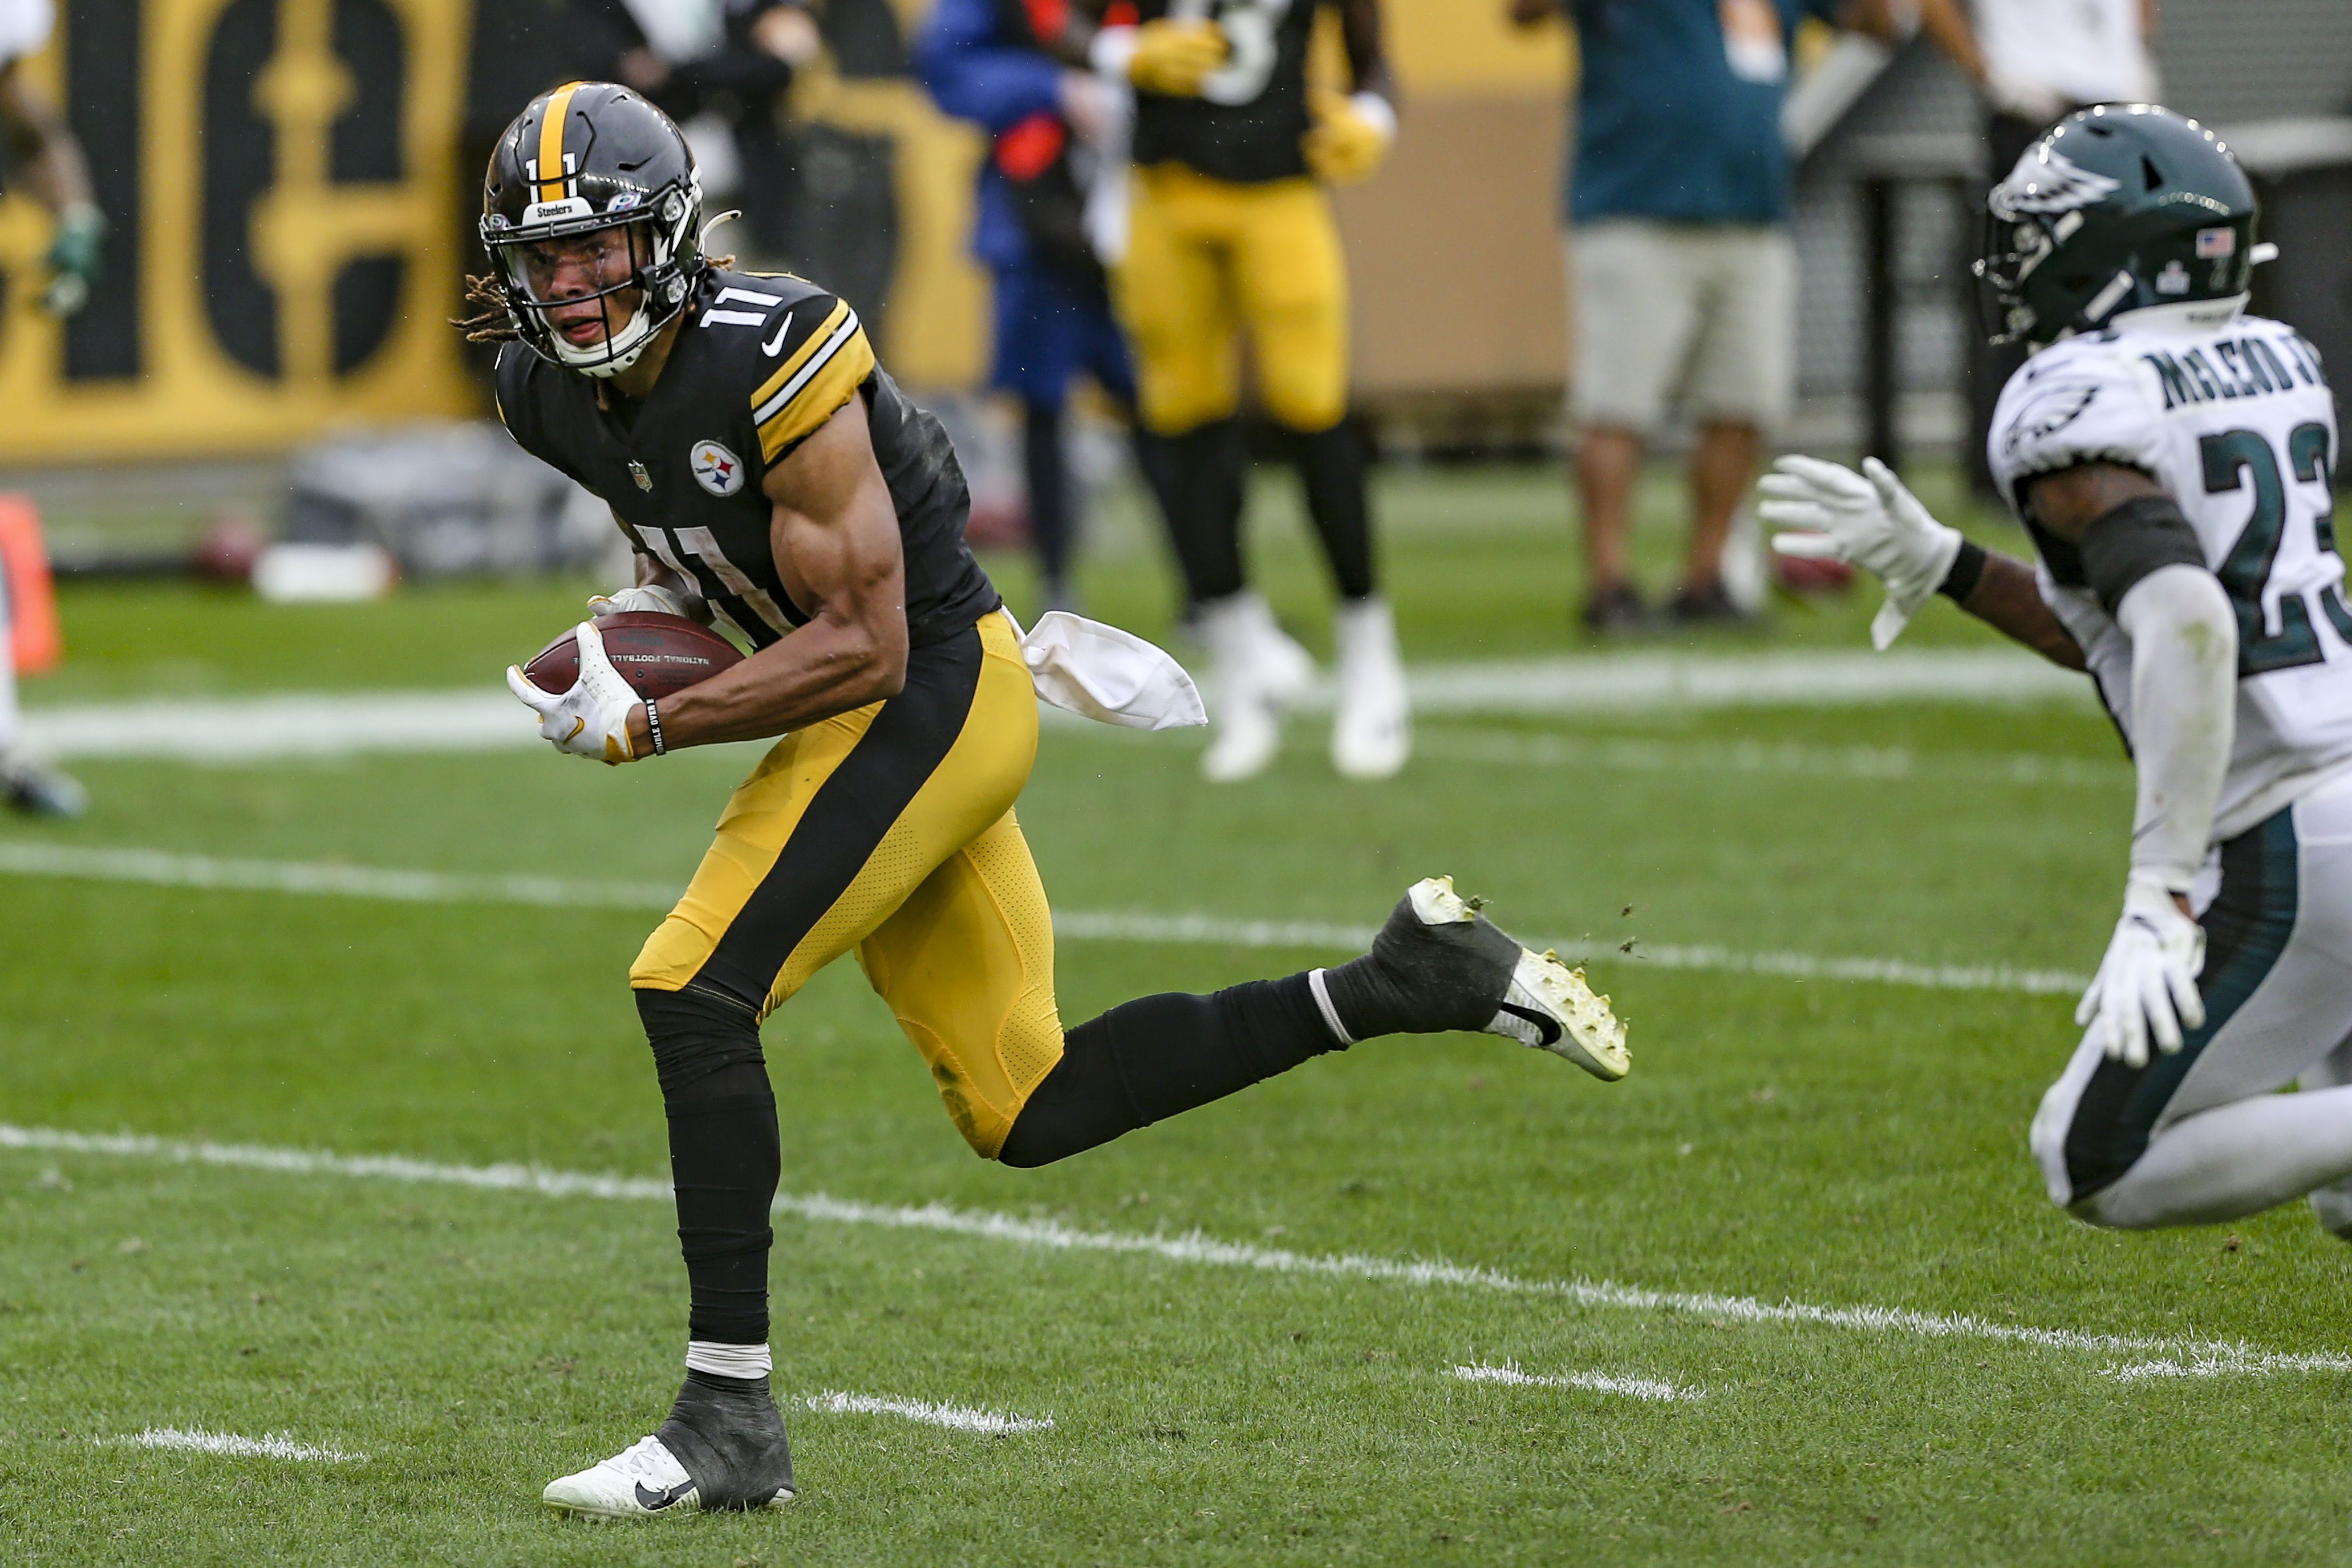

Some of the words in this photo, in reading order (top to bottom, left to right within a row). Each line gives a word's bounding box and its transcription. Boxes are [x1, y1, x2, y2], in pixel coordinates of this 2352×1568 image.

[525, 152, 578, 204] 11
[537, 204, 572, 217] Steelers
[699, 286, 784, 328] 11
[633, 524, 797, 648] 11
[611, 655, 660, 663] FOOTBALL
[664, 655, 709, 665] NATIONAL
[647, 705, 659, 725] OVER
